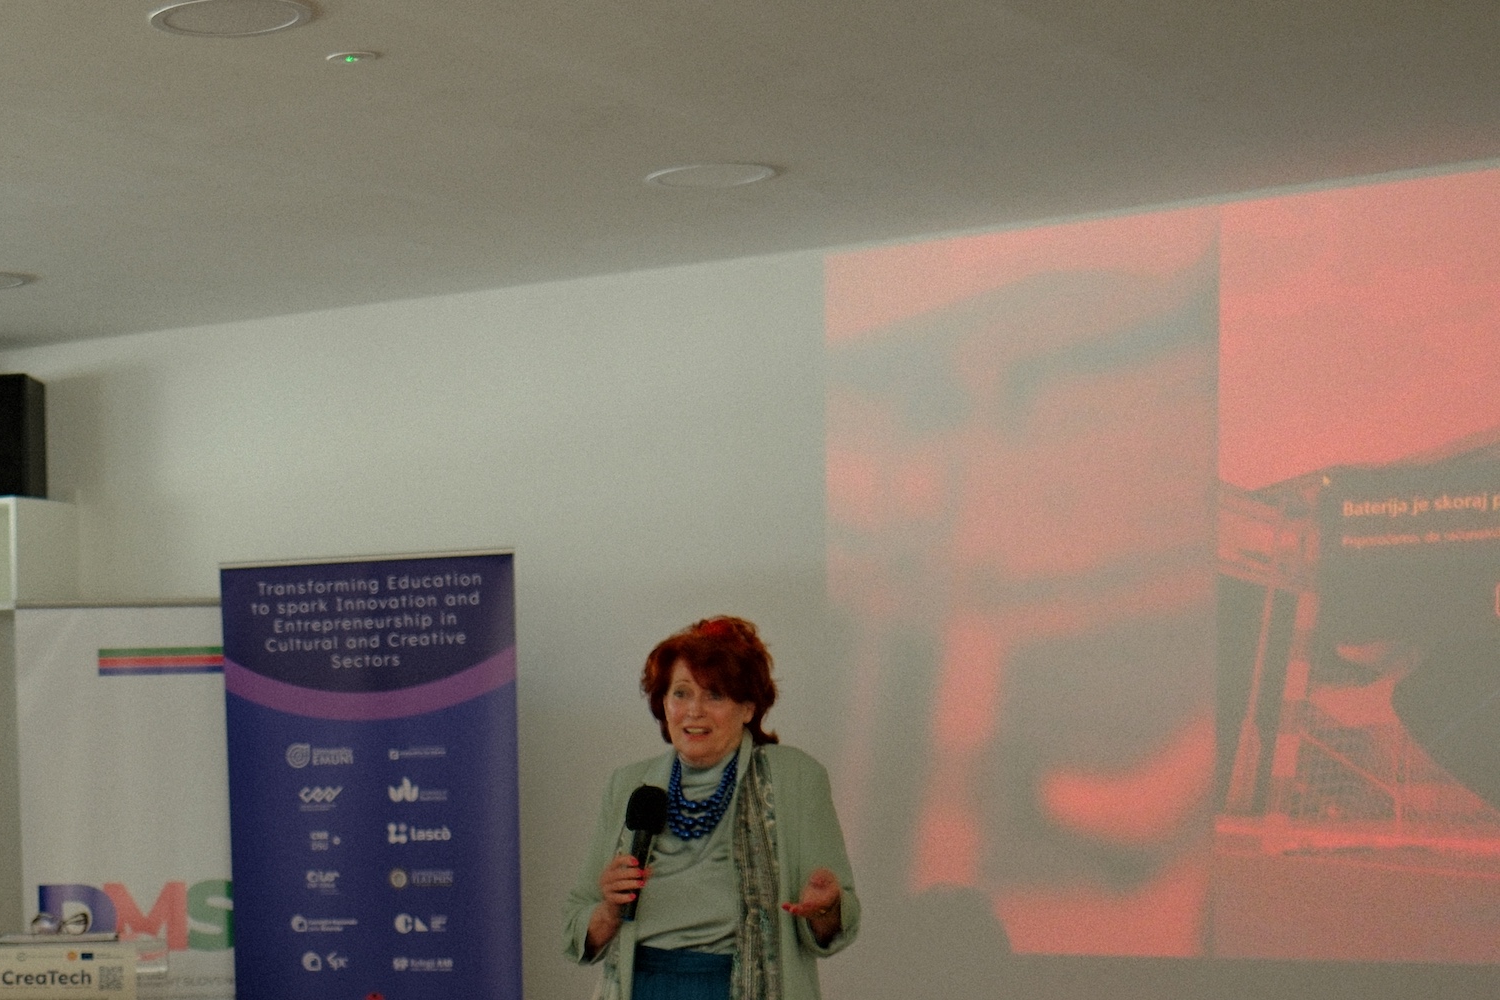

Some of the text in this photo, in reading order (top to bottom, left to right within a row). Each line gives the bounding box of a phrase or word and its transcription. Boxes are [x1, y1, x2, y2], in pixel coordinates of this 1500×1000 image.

[1342, 498, 1408, 518] Baterija
[1411, 496, 1430, 516] je
[1433, 492, 1487, 512] skoraj
[257, 572, 482, 597] Transforming Education
[251, 591, 480, 617] to spark Innovation and
[273, 612, 457, 635] Entrepreneurship in
[265, 631, 467, 653] Cultural and Creative
[331, 653, 401, 670] Sectors
[38, 879, 234, 951] DMS
[1, 969, 92, 986] CreaTech
